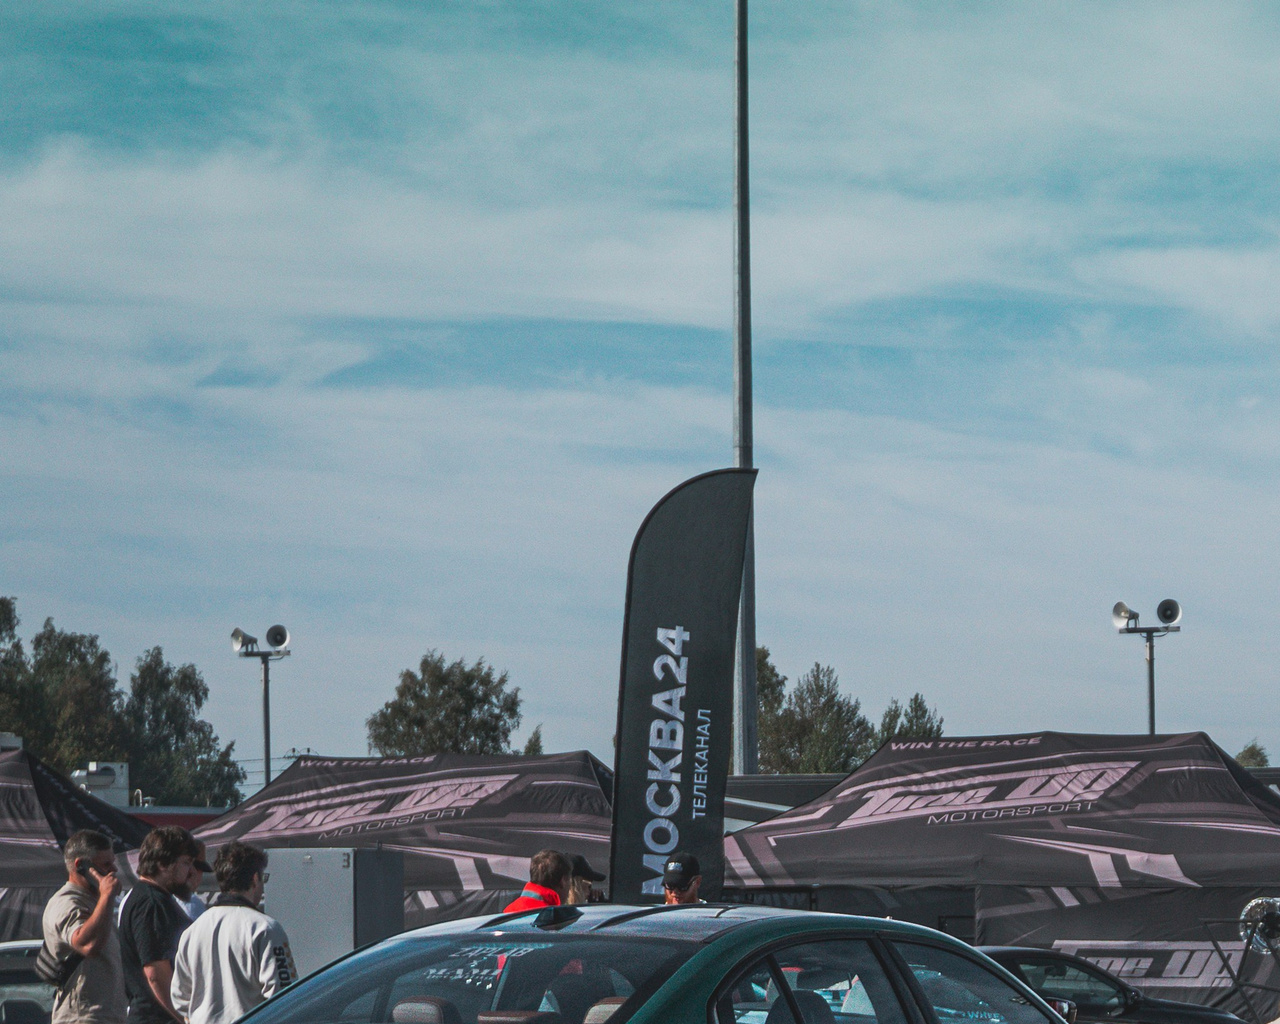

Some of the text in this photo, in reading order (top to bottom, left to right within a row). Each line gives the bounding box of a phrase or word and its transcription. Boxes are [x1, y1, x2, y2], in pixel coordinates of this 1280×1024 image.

[890, 737, 1042, 751] WIN THE RACE
[300, 759, 338, 767] WIN
[380, 755, 437, 765] RACE
[641, 625, 690, 896] МОСКВА24
[692, 708, 711, 819] ТЕЛЕКАНАЛ
[318, 807, 471, 840] MOTORSPORT
[927, 800, 1098, 824] MOTORSPORT
